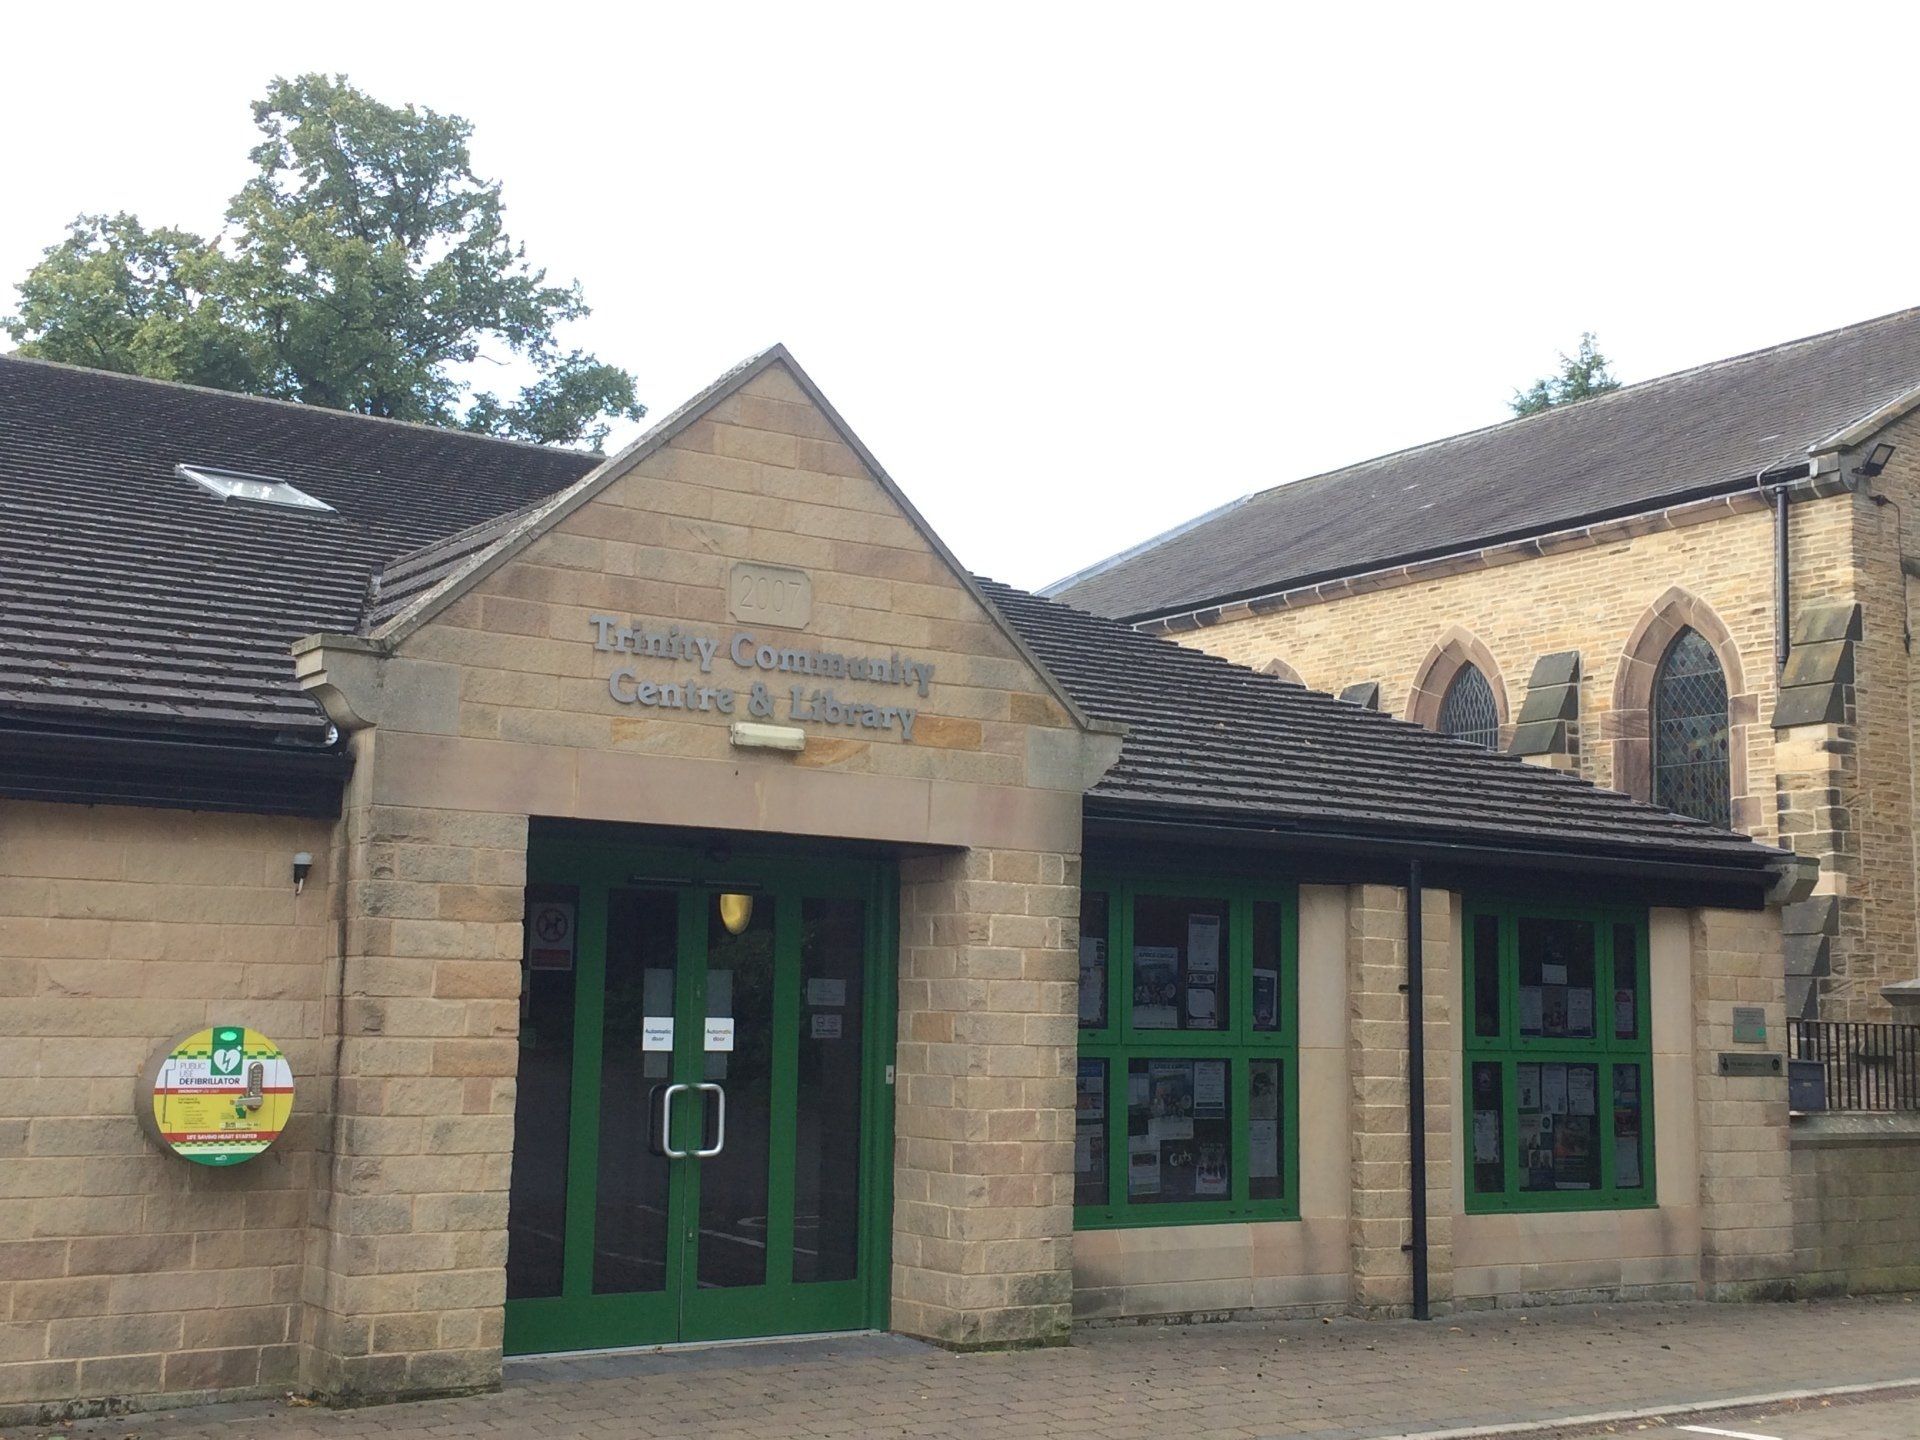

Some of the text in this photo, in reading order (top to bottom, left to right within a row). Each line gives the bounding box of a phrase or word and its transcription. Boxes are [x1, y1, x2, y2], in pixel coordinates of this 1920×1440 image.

[740, 575, 802, 613] 2007
[589, 614, 935, 698] Trinity Community
[608, 666, 918, 742] Centre & Library
[179, 1077, 240, 1085] DEFIBRILLATOR
[180, 1062, 206, 1070] PUBLIC
